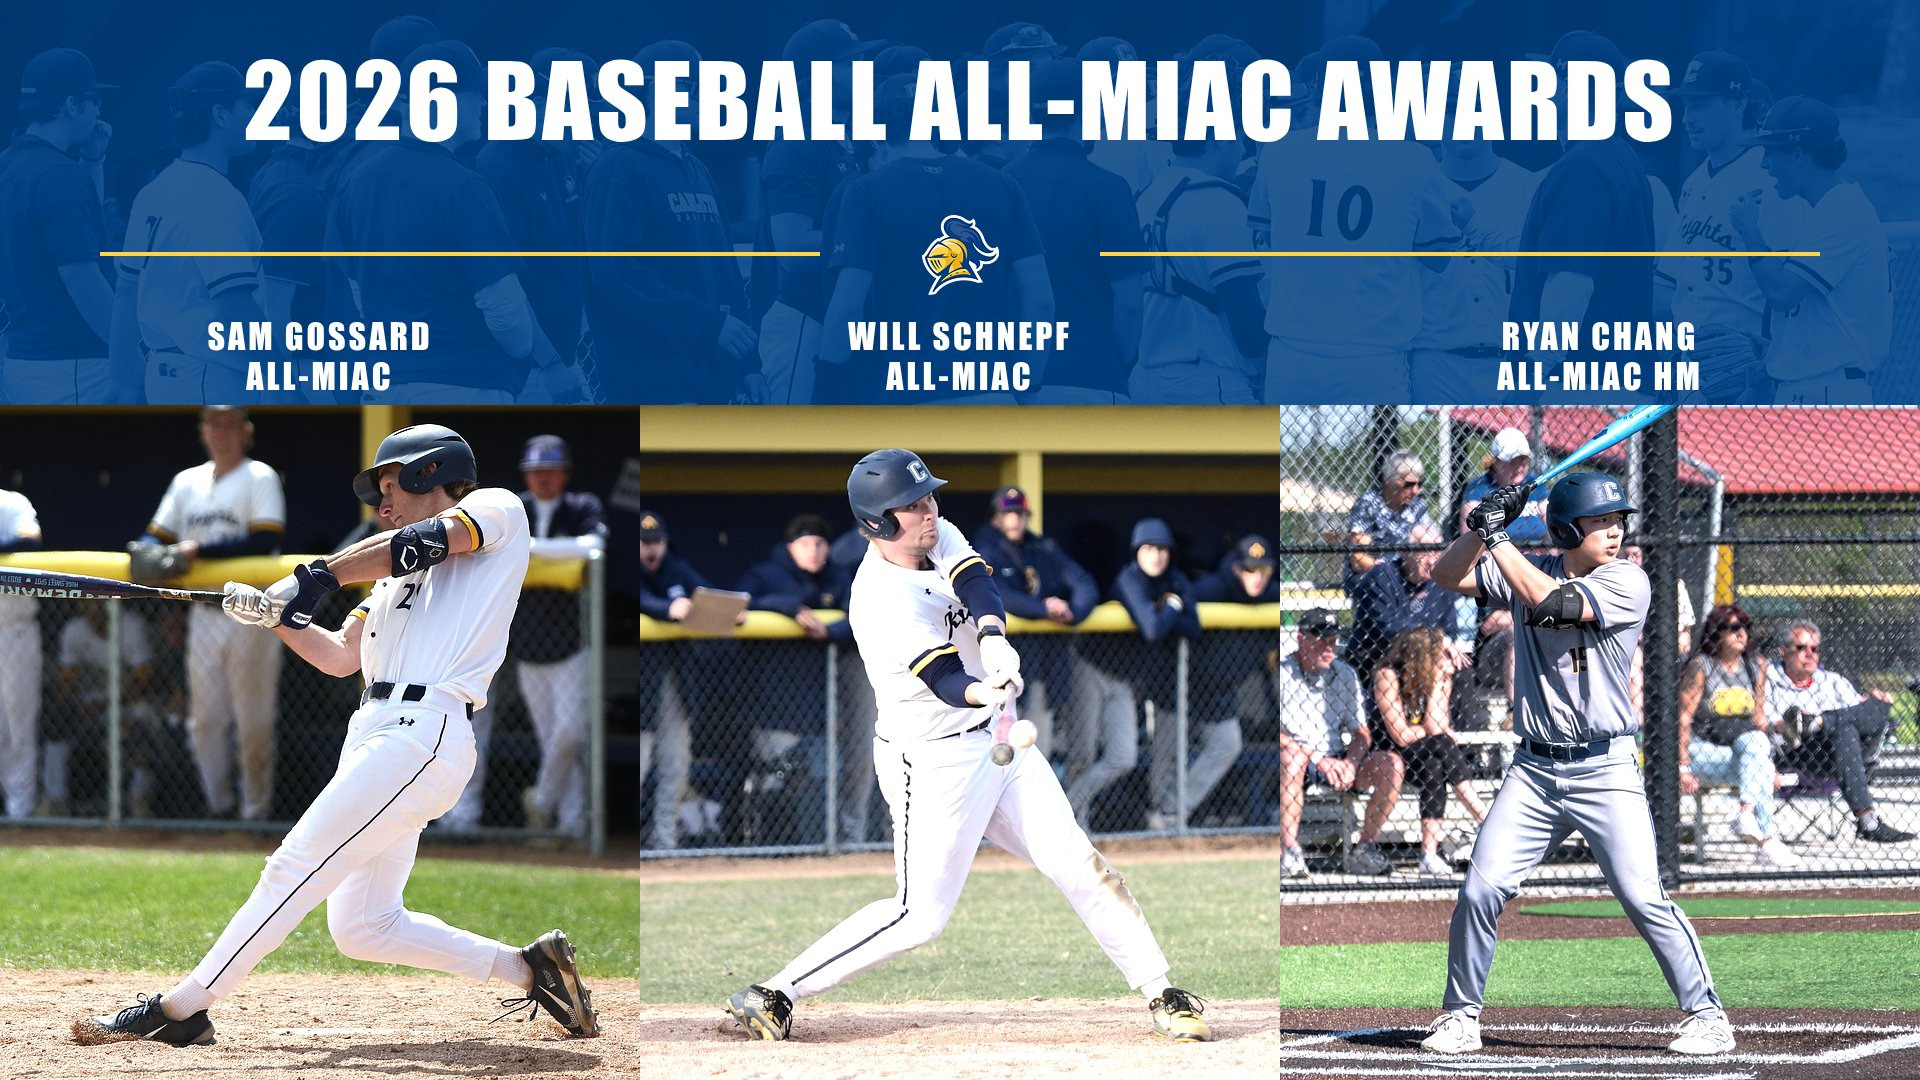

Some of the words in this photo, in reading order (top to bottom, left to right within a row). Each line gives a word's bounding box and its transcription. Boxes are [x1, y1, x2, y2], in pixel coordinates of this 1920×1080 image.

[1306, 178, 1373, 241] 10
[1702, 256, 1733, 286] 35
[907, 461, 929, 483] C
[1602, 481, 1622, 502] C
[396, 582, 422, 610] 2
